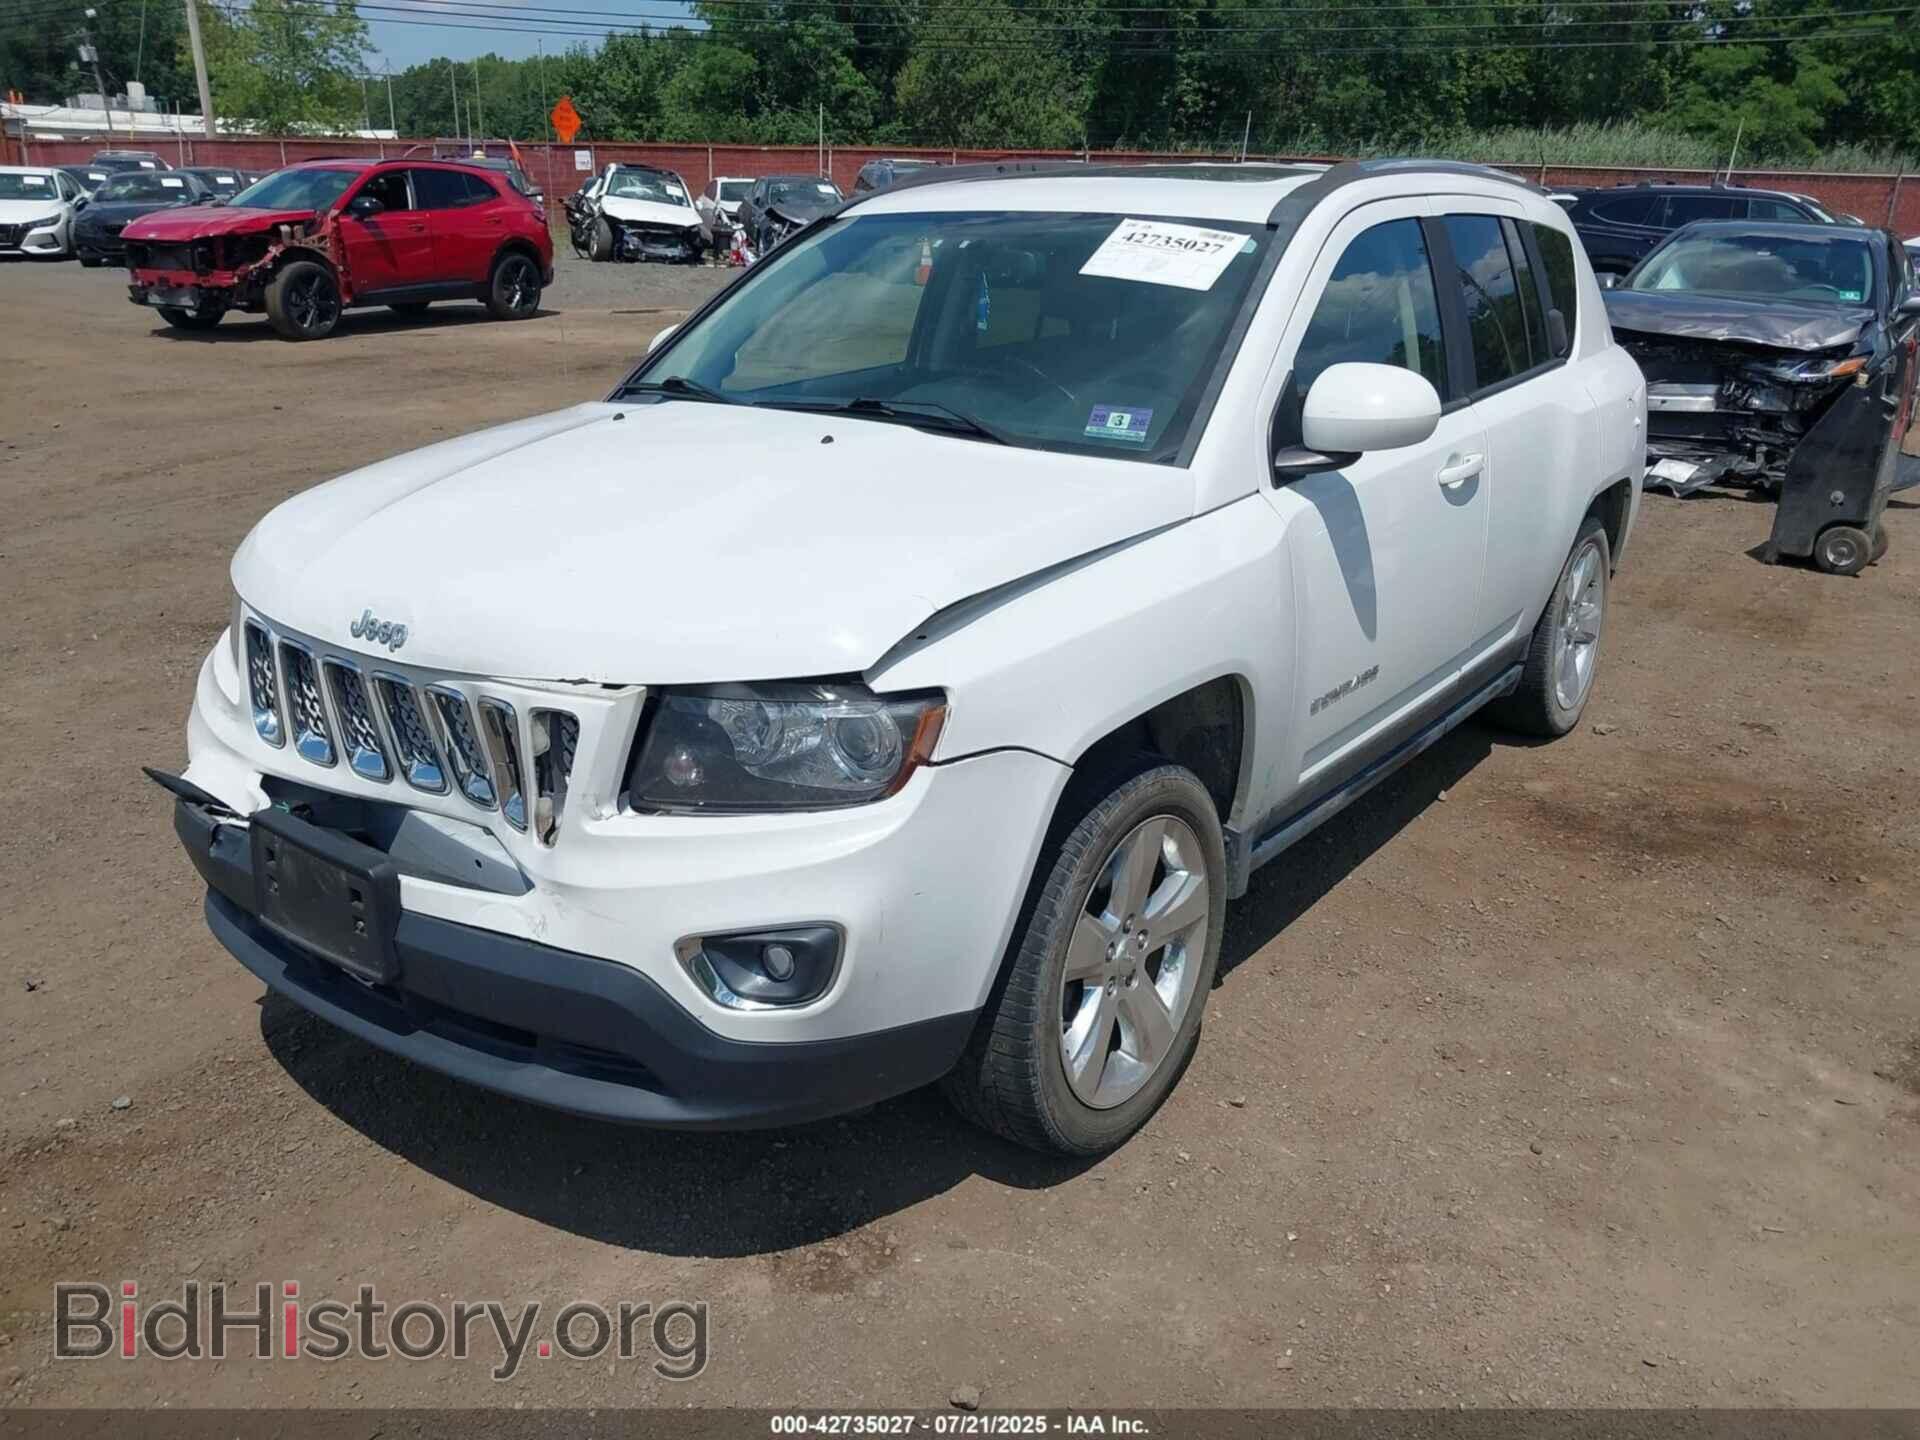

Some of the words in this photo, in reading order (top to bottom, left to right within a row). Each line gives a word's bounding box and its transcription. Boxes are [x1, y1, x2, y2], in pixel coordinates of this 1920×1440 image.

[1122, 232, 1224, 254] 42735027
[1114, 415, 1124, 426] 3
[350, 609, 408, 653] Jeep
